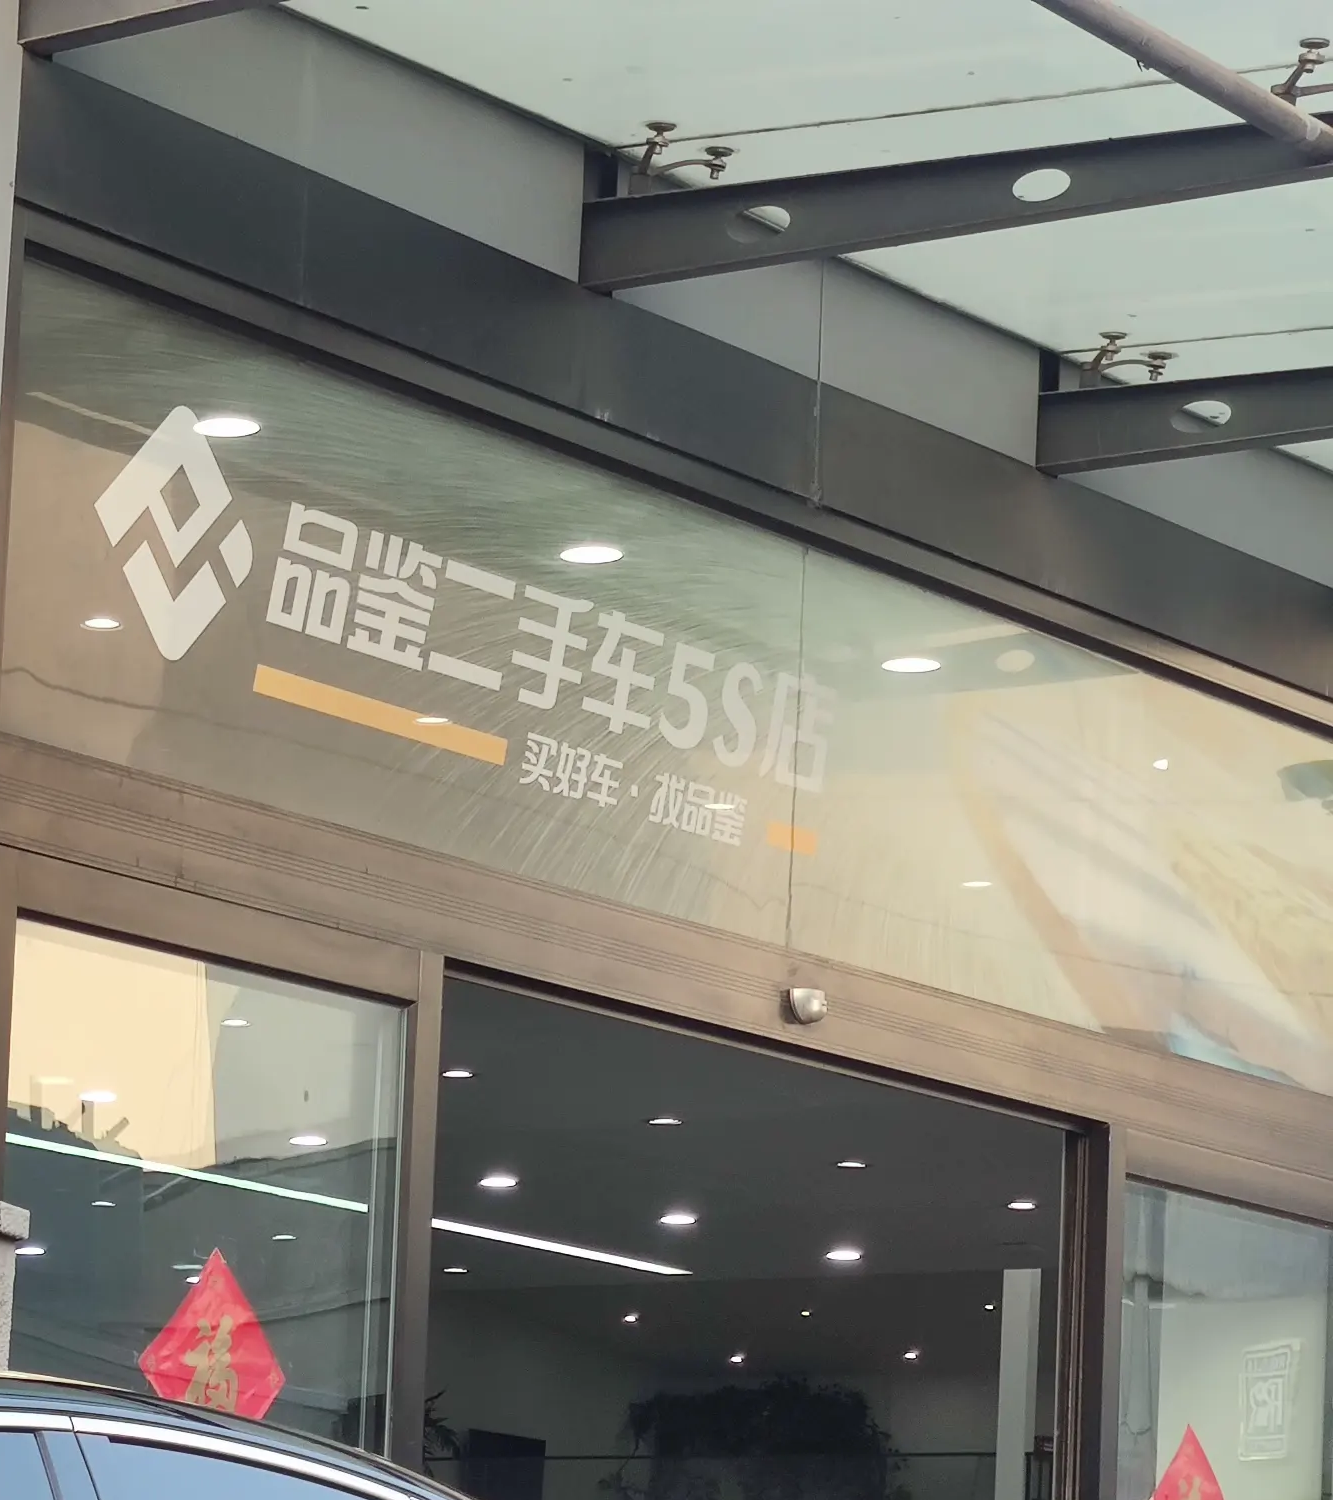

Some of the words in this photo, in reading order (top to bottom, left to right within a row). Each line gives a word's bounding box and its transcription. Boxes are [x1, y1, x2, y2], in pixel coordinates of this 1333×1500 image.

[265, 501, 838, 792] 品鉴二手车5S店
